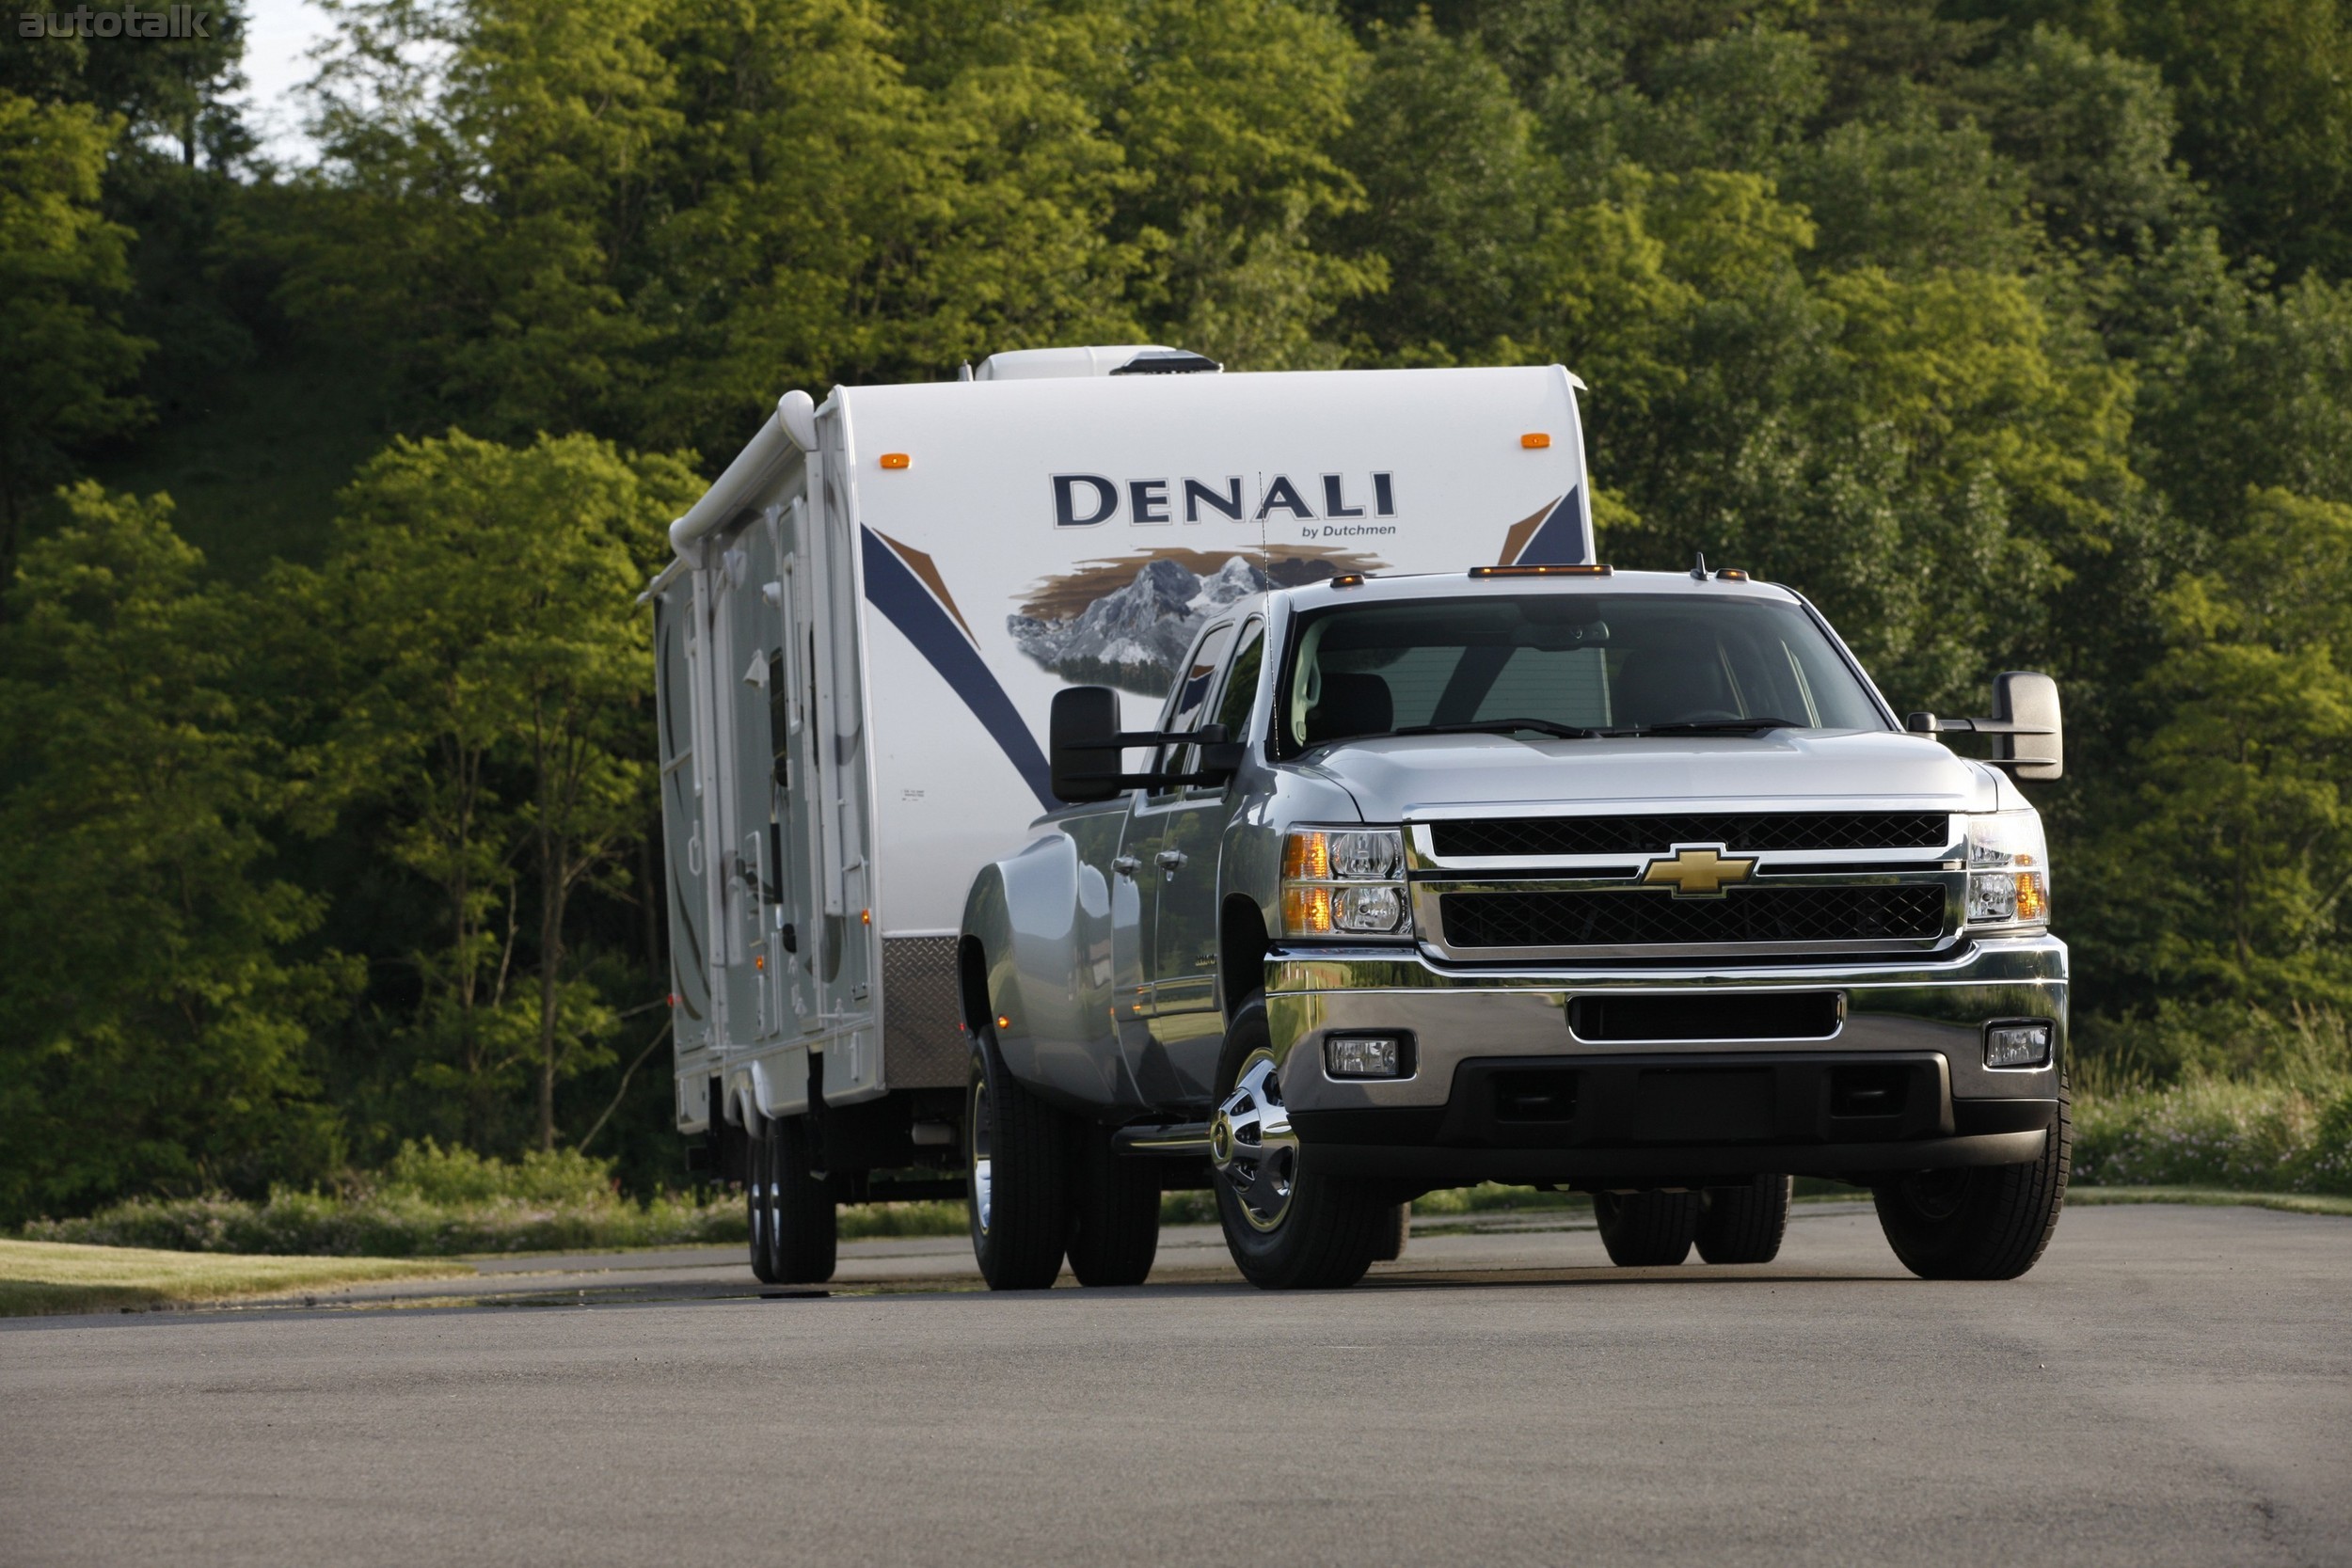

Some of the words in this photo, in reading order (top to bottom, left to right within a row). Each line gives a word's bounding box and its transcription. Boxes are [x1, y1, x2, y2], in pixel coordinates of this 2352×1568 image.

[1049, 470, 1399, 530] DENALI
[1302, 527, 1319, 540] by
[1323, 525, 1396, 537] Dutchmen
